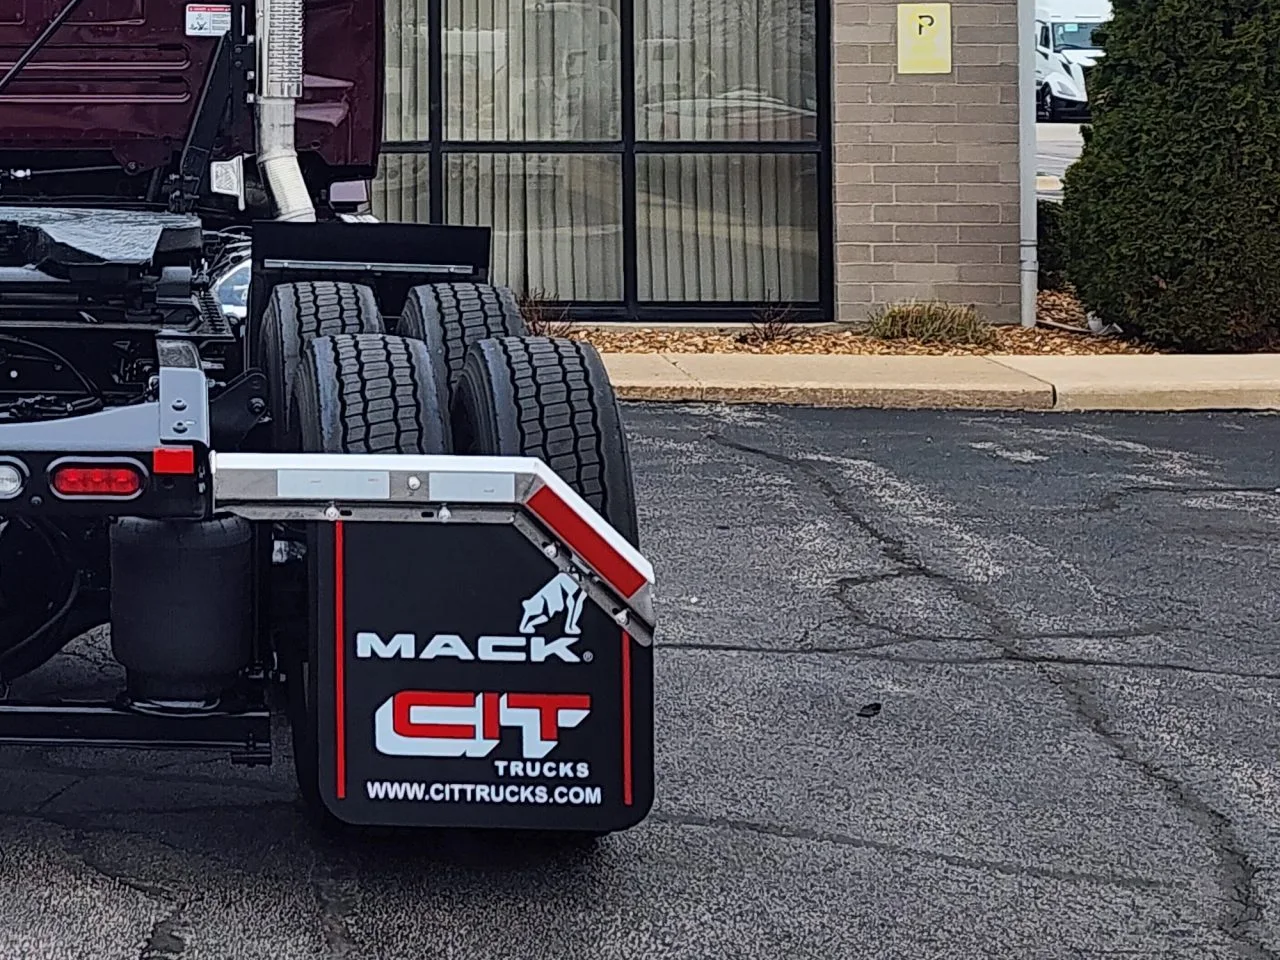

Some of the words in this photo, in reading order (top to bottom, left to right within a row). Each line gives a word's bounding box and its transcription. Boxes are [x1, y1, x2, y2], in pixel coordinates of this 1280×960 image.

[917, 14, 935, 36] P
[356, 632, 581, 663] MACK
[376, 690, 591, 758] CIT
[494, 760, 589, 778] TRUCKS
[367, 781, 602, 804] WWW.CITTRUCKS.COM
